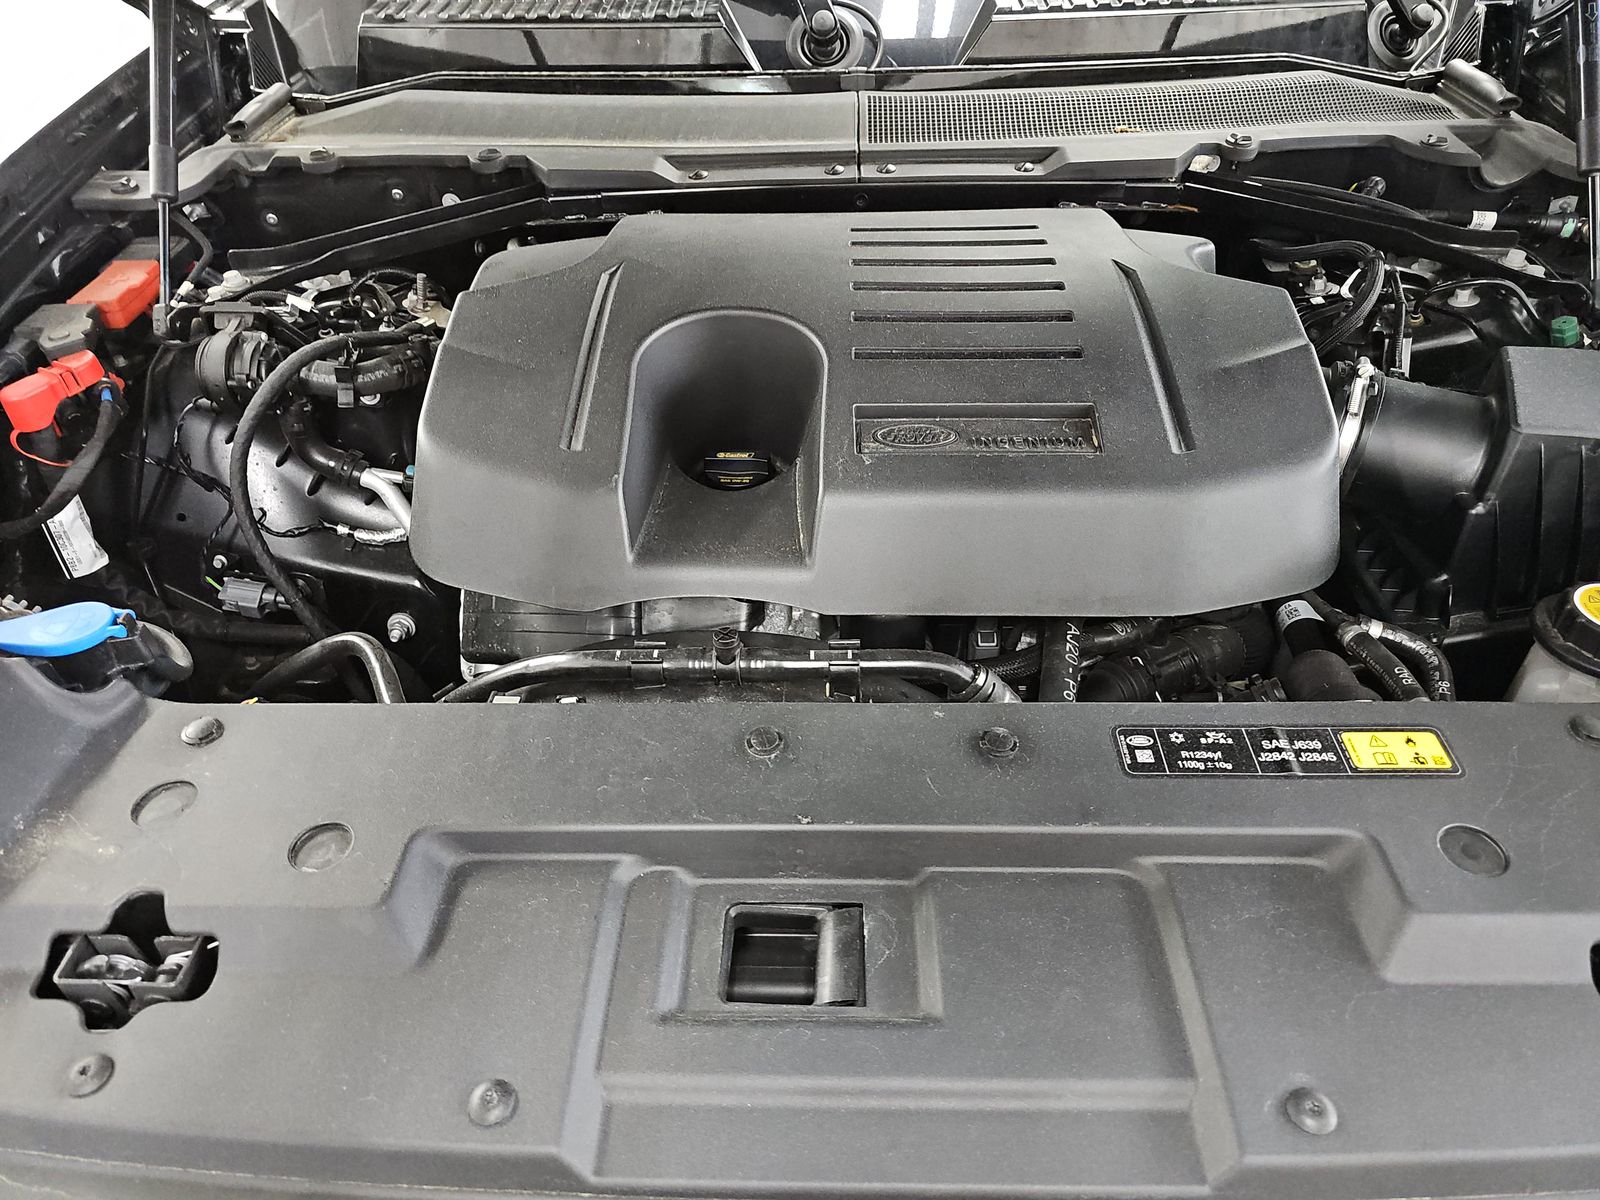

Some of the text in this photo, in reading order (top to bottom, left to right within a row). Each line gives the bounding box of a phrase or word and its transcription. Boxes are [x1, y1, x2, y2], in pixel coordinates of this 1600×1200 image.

[971, 436, 1087, 450] INGENIUM
[1394, 666, 1417, 686] RAD
[1262, 739, 1322, 750] SAE J639
[1181, 751, 1222, 760] R1234yf
[1258, 752, 1337, 762] J2842 J2845
[1177, 760, 1205, 770] 1100g
